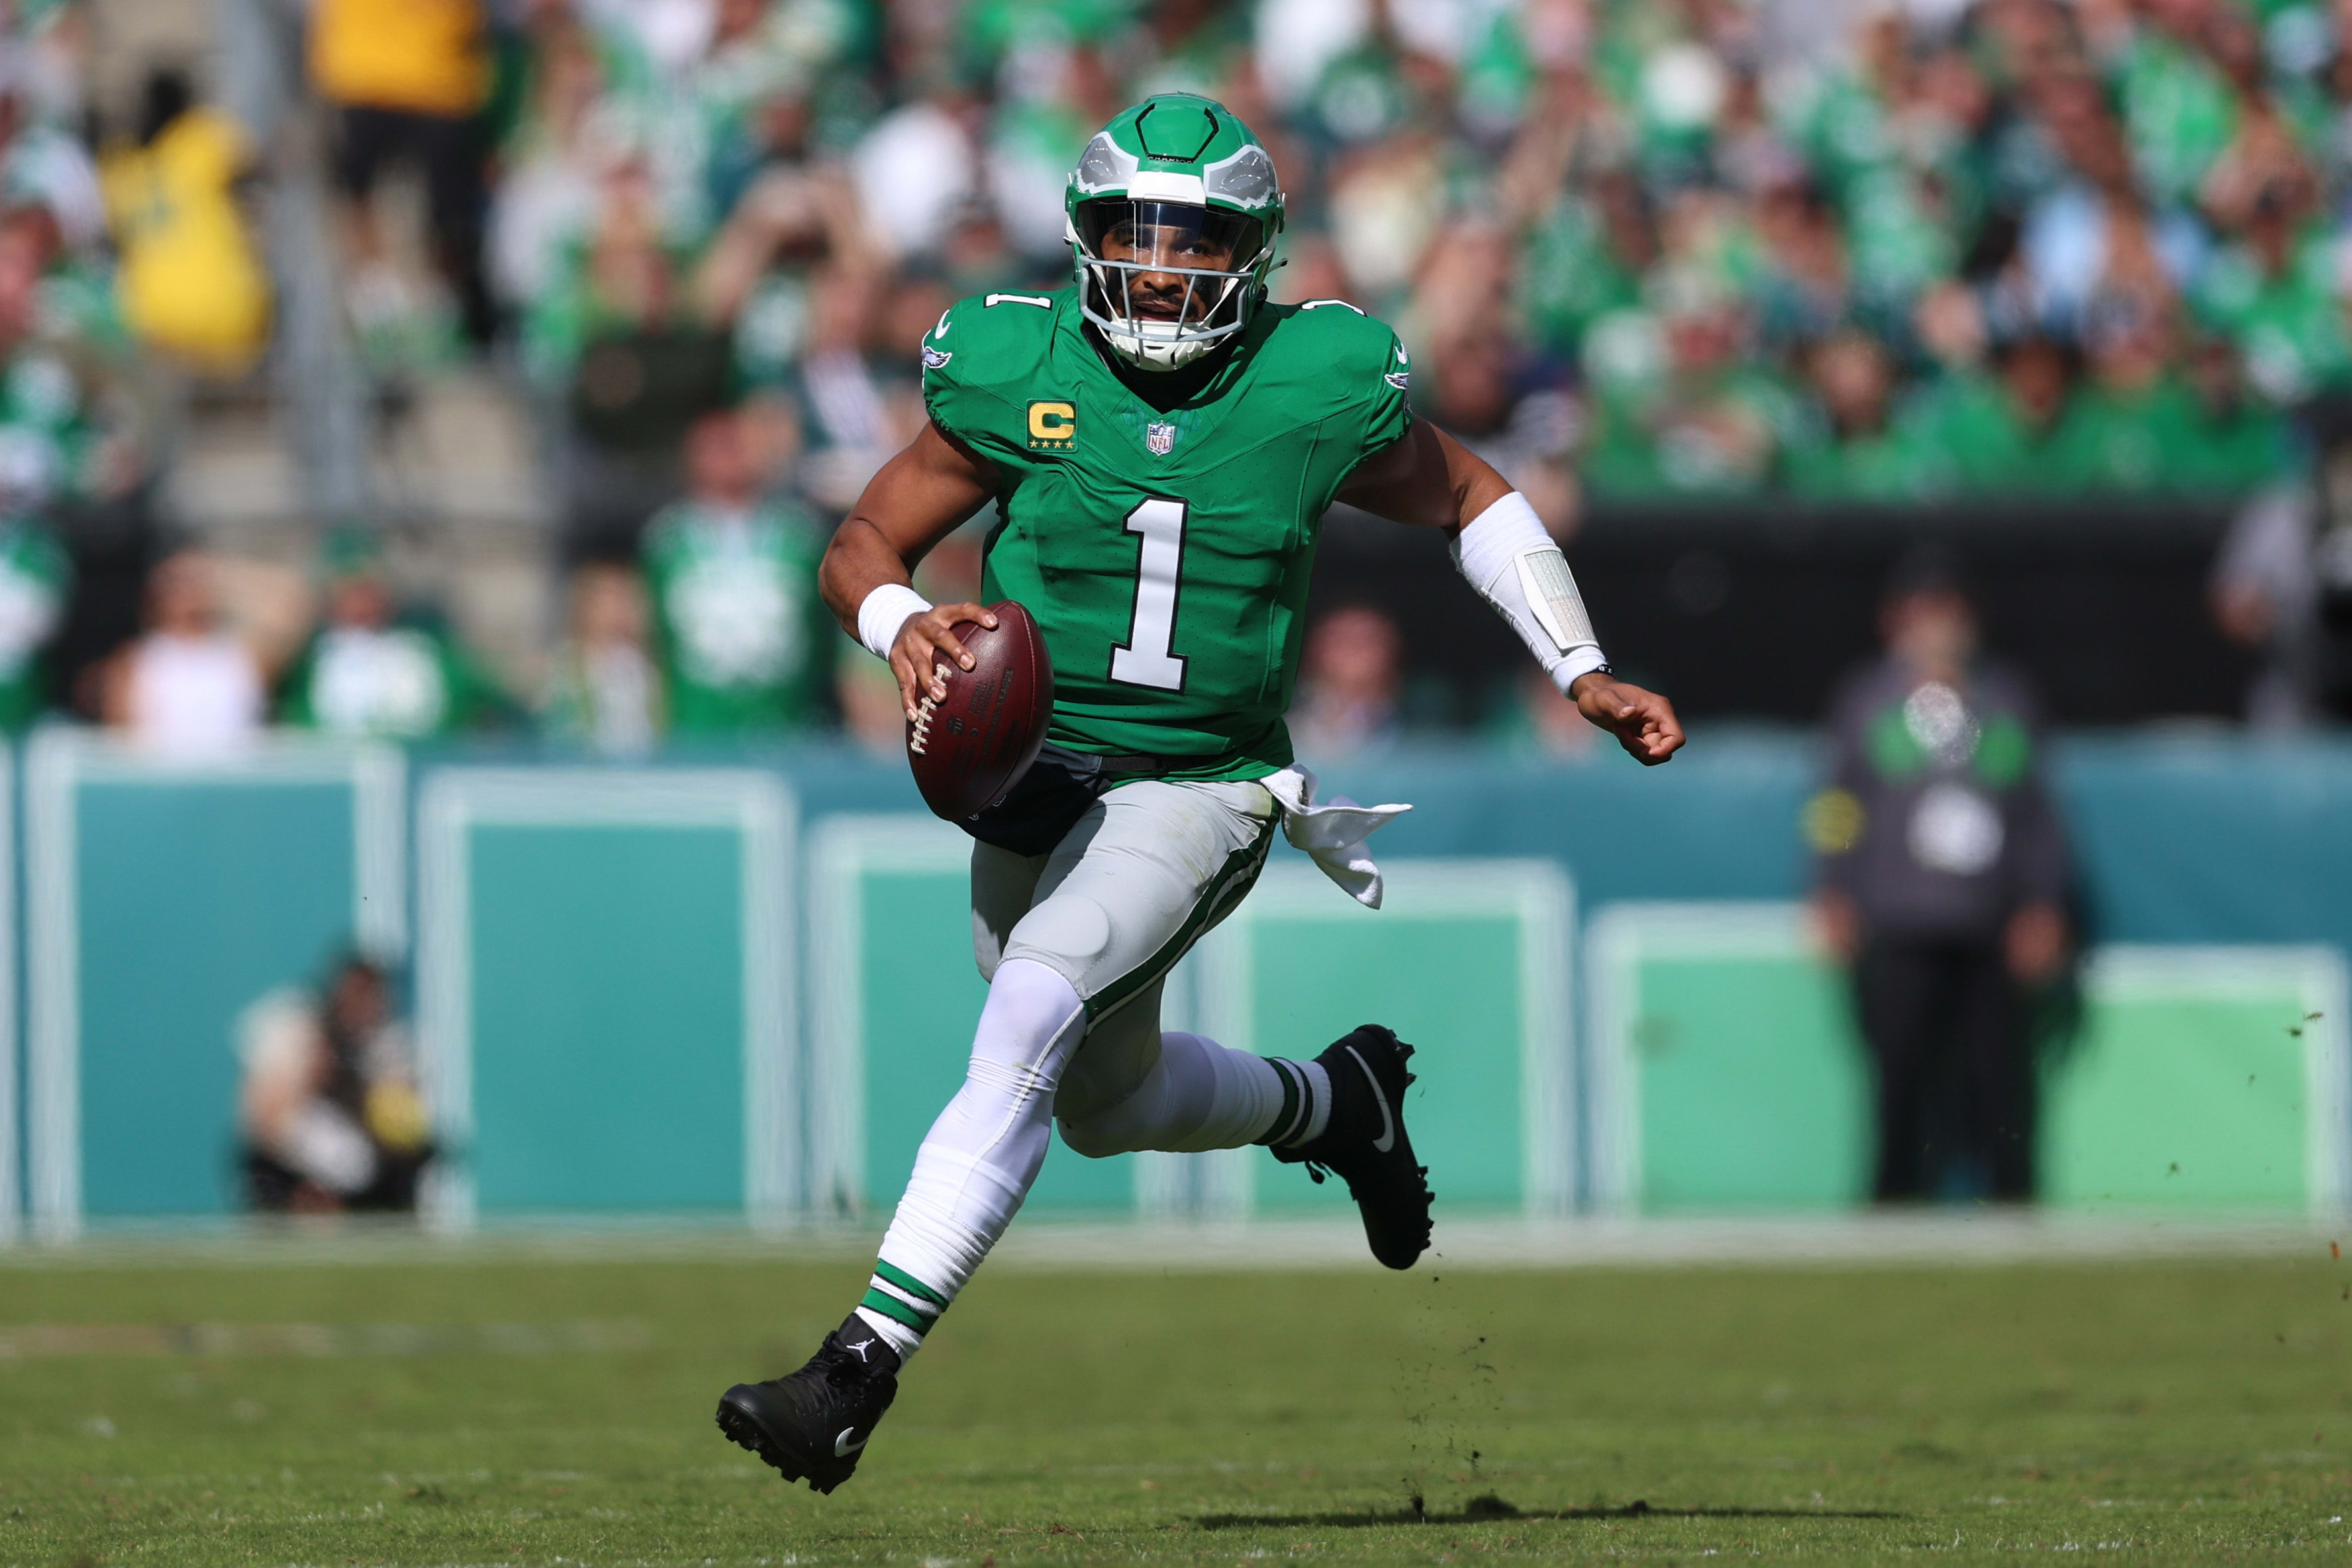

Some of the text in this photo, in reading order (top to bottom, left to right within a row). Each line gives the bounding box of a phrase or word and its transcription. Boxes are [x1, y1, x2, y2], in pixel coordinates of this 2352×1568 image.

[985, 293, 1052, 310] 1
[1029, 403, 1074, 439] C
[1151, 436, 1169, 450] NFL
[1107, 496, 1188, 694] 1
[996, 667, 1013, 706] LEAGUE
